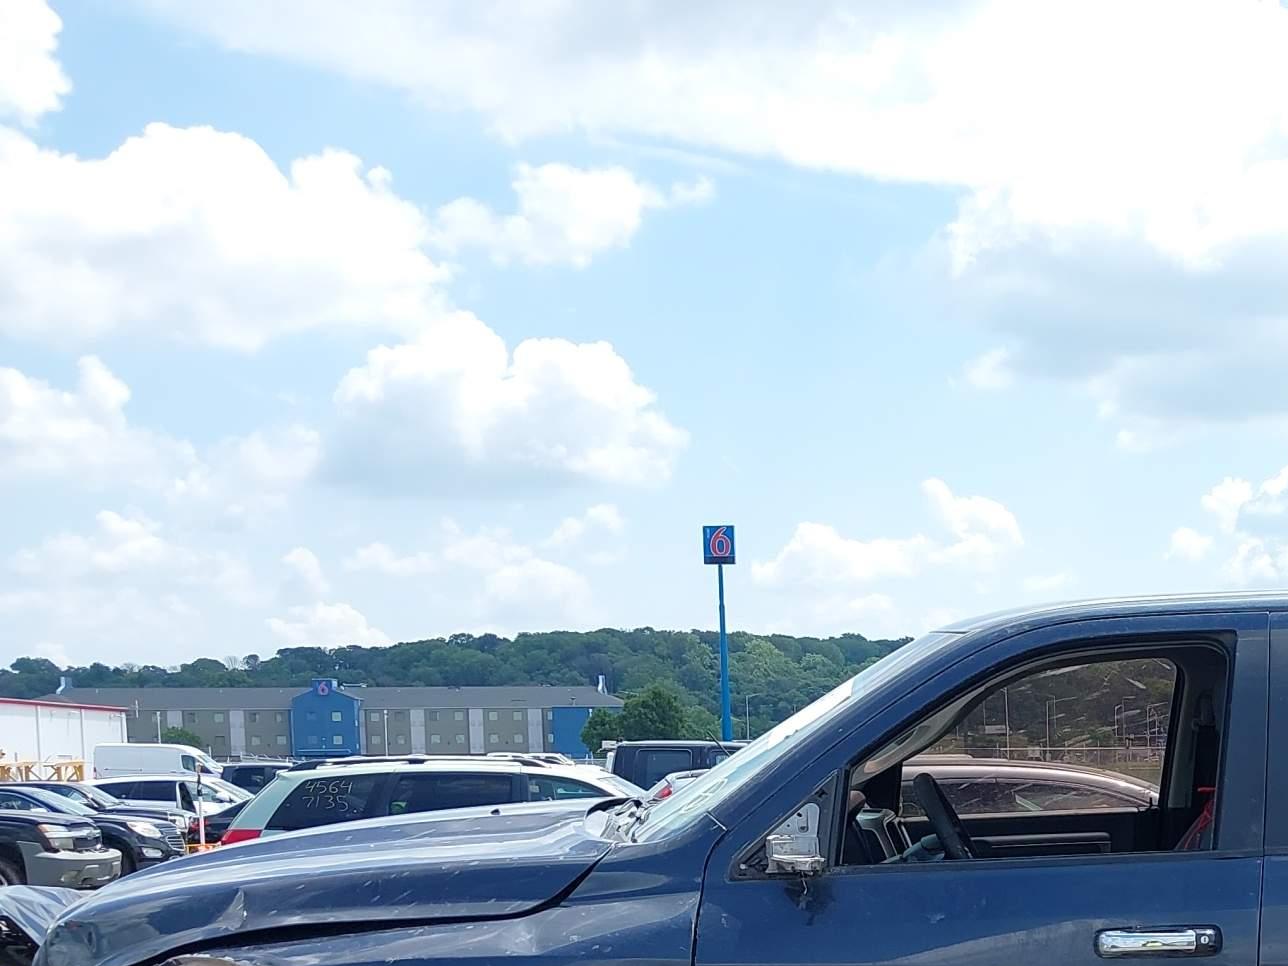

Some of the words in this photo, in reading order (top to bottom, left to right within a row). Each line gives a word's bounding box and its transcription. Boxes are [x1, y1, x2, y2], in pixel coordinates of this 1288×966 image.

[710, 526, 731, 557] 6
[318, 681, 329, 696] 6
[305, 780, 353, 794] 4564
[302, 795, 349, 812] 7135
